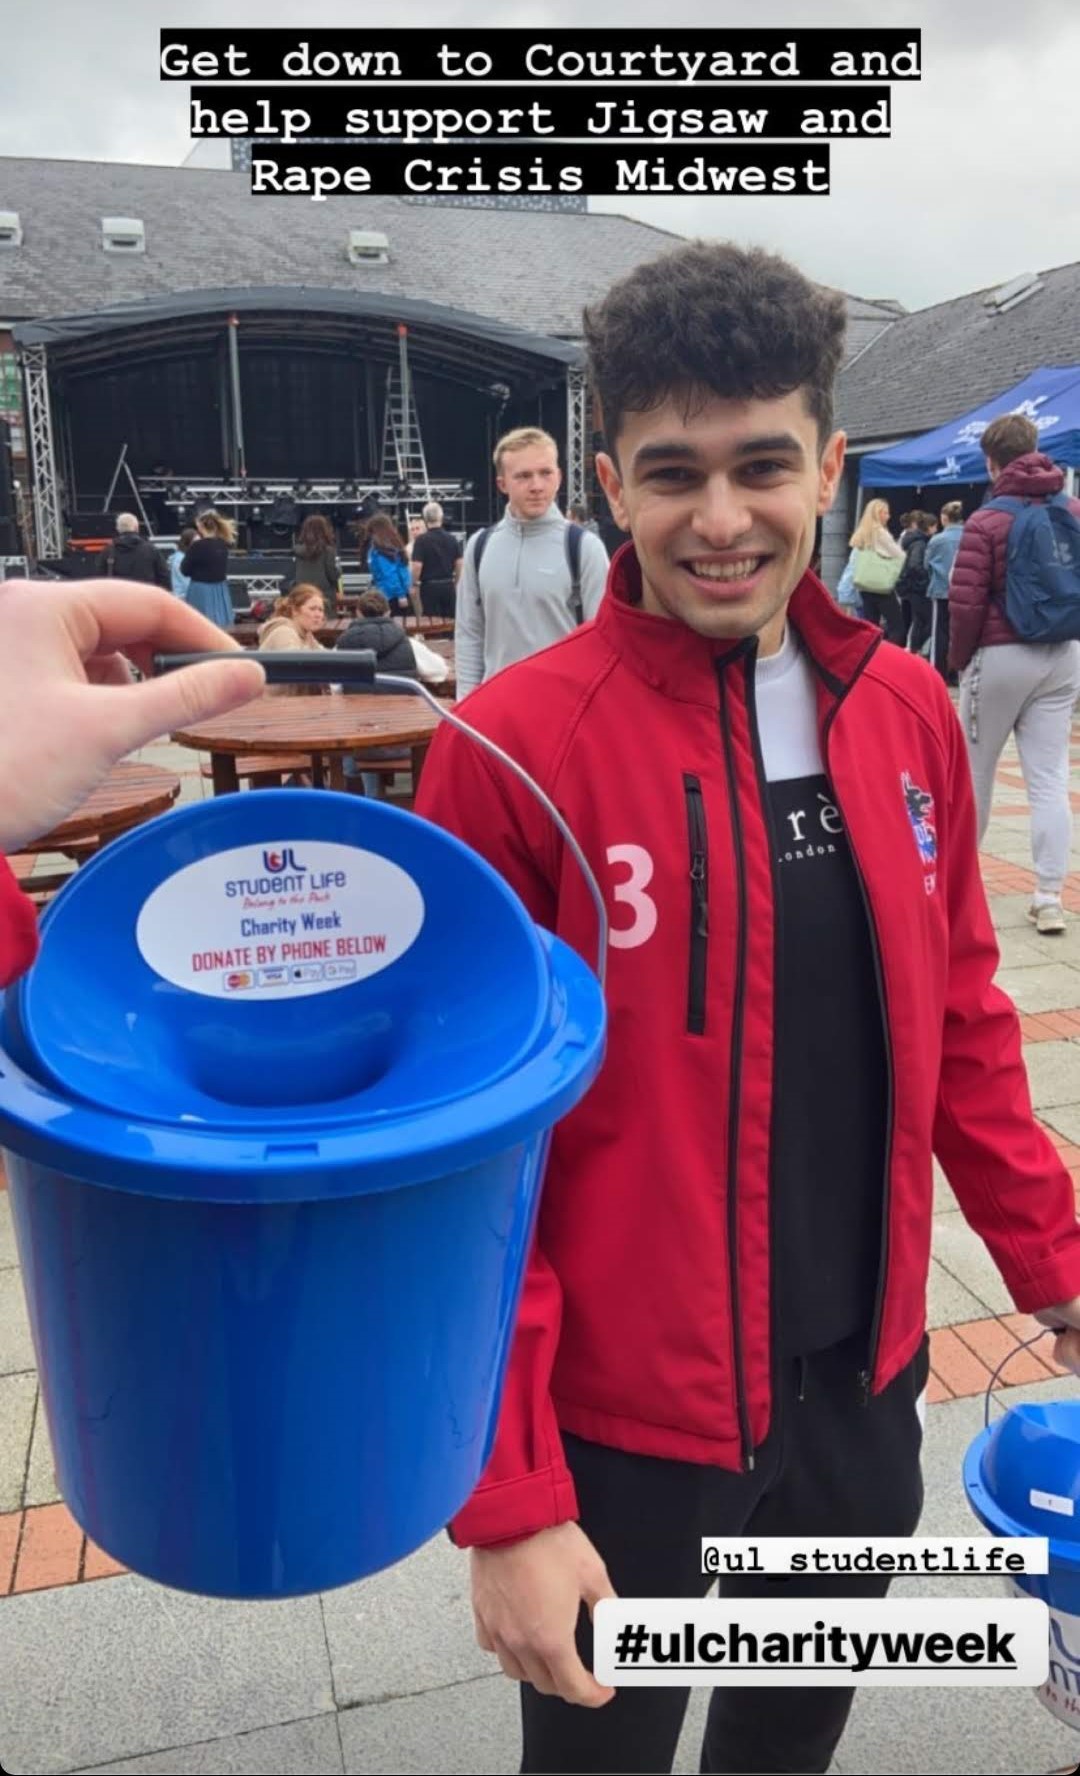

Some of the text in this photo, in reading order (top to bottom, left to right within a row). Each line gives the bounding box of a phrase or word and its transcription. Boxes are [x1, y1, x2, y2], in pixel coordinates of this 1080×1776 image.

[263, 848, 307, 874] UL
[778, 844, 836, 863] ondon
[605, 843, 658, 949] 3
[240, 911, 342, 938] Charity Week
[192, 935, 387, 972] DONATE BY PHONE BELOW
